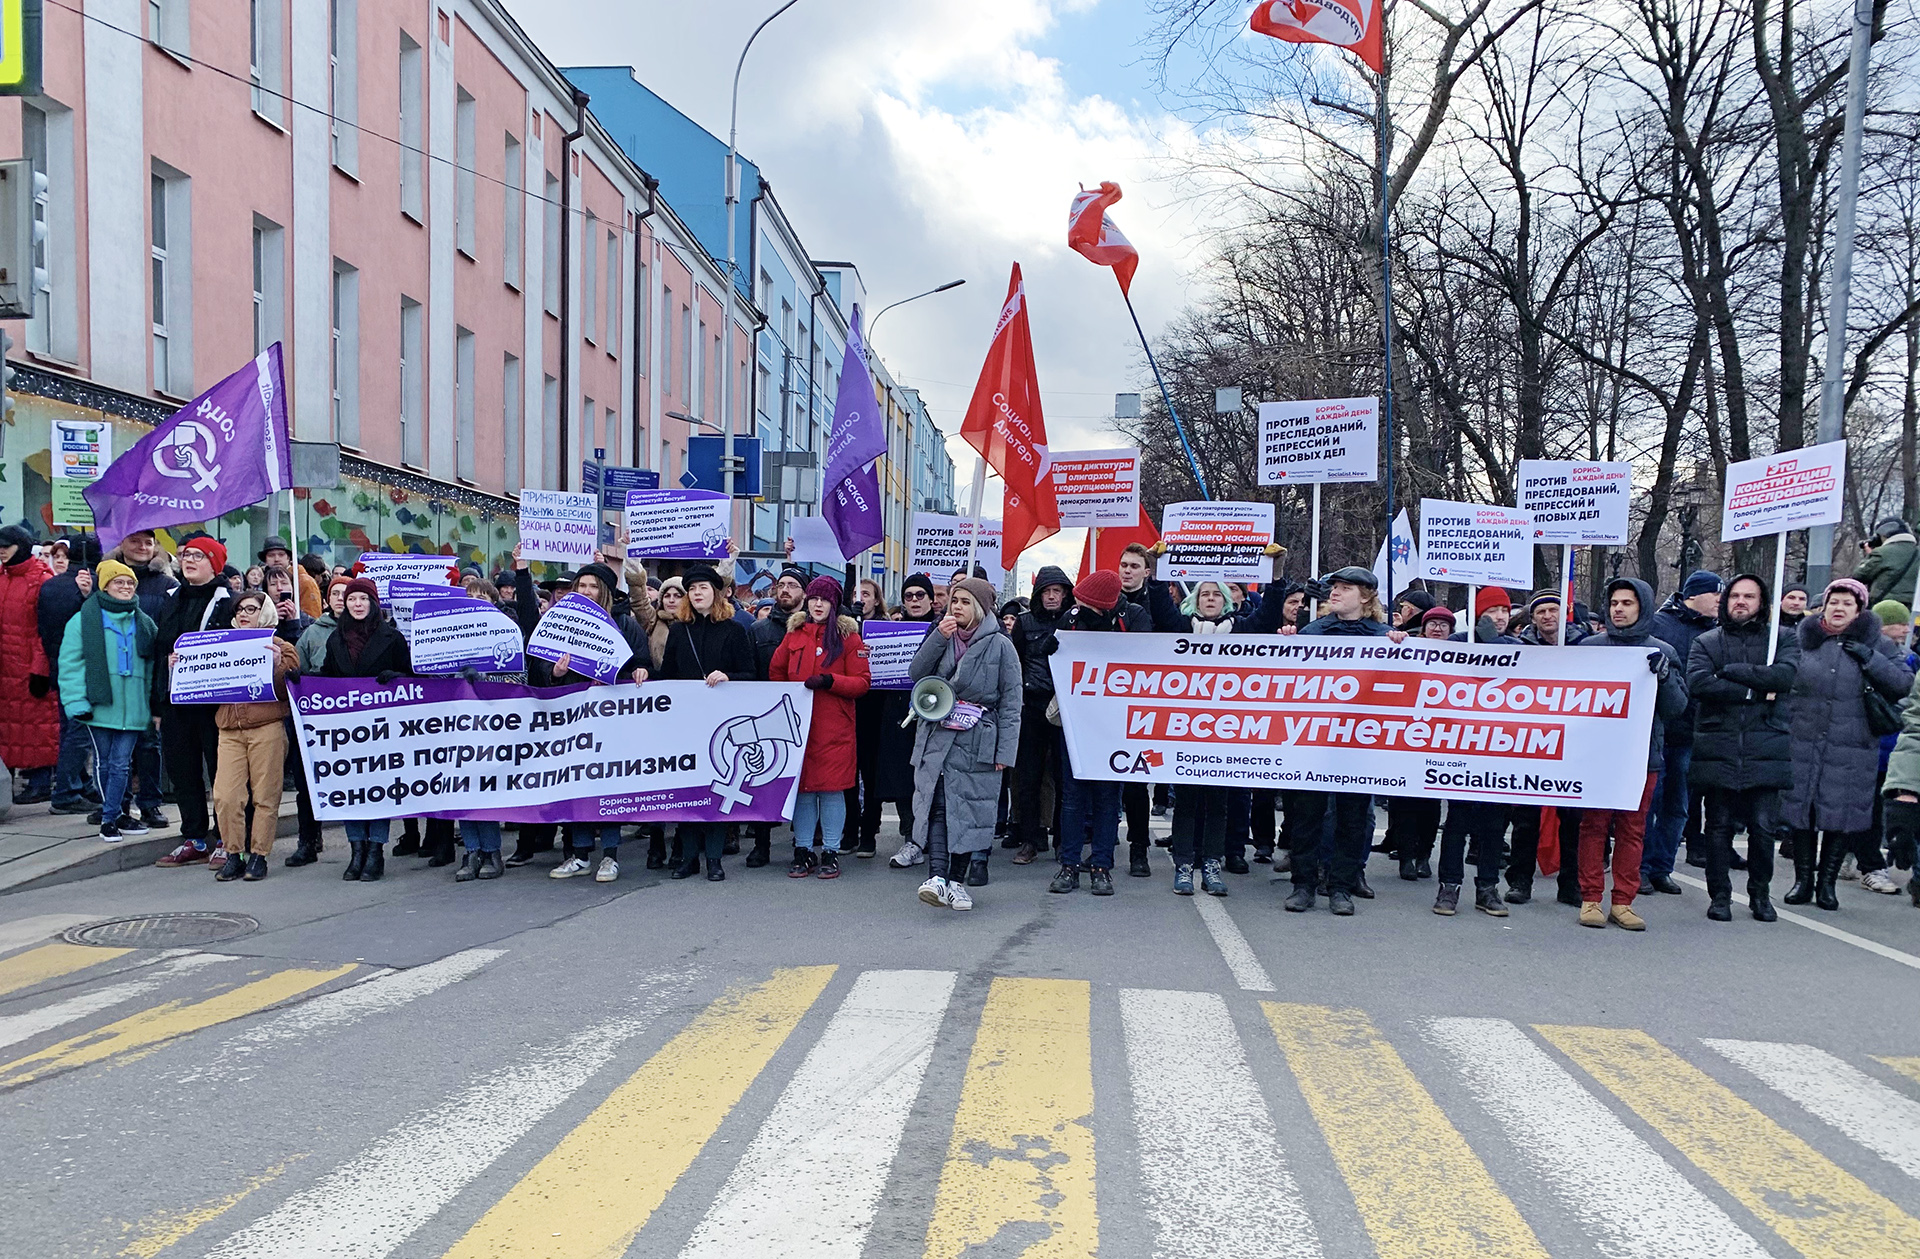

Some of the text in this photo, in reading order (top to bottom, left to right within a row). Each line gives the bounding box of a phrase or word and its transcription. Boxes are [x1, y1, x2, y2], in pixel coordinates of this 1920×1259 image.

[1315, 404, 1346, 414] БОРИСЬ
[1315, 408, 1372, 421] КАЖДЫЙ ДЕНЬ!
[1266, 417, 1310, 430] ПРОТИВ
[1266, 420, 1367, 442] ПРЕСЛЕДОВАНИЙ,
[1266, 436, 1340, 454] РЕПРЕССИЙ И
[1265, 448, 1346, 466] ЛИПОВЫХ ДЕЛ
[1052, 462, 1132, 472] Против диктатуры
[1767, 461, 1797, 475] Эта
[1068, 473, 1114, 482] олигархов
[1526, 477, 1567, 488] ПРОТИВ
[1572, 473, 1604, 482] КАЖДЫЙ
[1736, 468, 1830, 495] конституция
[1059, 482, 1132, 493] коррупционеров
[1525, 483, 1620, 500] ПРЕСЛЕДОВАНИЙ,
[1730, 479, 1834, 509] неисправима
[522, 492, 594, 506] ПРИНЯТЬ ИЗНА-
[1525, 497, 1595, 510] РЕПРЕССИЙ И
[520, 505, 592, 519] ЧАЛЬНУЮ ВЕРСИЮ
[630, 507, 679, 517] Антиженской
[1734, 496, 1829, 518] Голосуй против поправок
[630, 516, 676, 526] государства
[1578, 510, 1600, 520] ДЕЛ
[520, 520, 552, 532] ЗАКОНА
[554, 522, 561, 532] О
[1182, 522, 1252, 532] Закон против
[1428, 518, 1470, 526] ПРОТИВ
[631, 532, 674, 543] движением!
[1164, 533, 1268, 542] домашнего насилия
[1428, 529, 1524, 540] ПРЕСЛЕДОВАНИЙ,
[520, 538, 592, 555] НЕМ НАСИЛИИ
[916, 538, 999, 548] ПРЕСЛЕДОВНИЙ,
[1175, 544, 1232, 554] кризисный
[1234, 546, 1264, 555] центр
[1428, 540, 1500, 550] РЕПРЕССИЙ И
[915, 548, 968, 557] РЕПРЕССИЙ
[1426, 552, 1505, 562] ЛИПОВЫХ ДЕЛ
[914, 558, 960, 566] ЛИПОВЫХ
[1180, 554, 1220, 564] каждый
[1222, 554, 1259, 566] район!
[364, 564, 446, 573] Сестёр Хачатурян
[370, 572, 420, 582] оправдать!
[546, 610, 601, 630] Прекратить
[432, 623, 475, 632] нападкам
[542, 621, 614, 646] преследование
[414, 630, 488, 646] репродуктивные
[536, 629, 614, 656] Юлии Цветковой
[875, 642, 902, 651] разовый
[1174, 638, 1521, 668] Эта конституция неисправима!
[180, 650, 228, 664] Руки прочь
[189, 663, 216, 673] права
[234, 655, 266, 668] аборт!
[297, 684, 424, 713] @SocFemAlt
[1072, 668, 1628, 716] Демократию рабочим
[302, 694, 672, 752] Строй женское движение
[1128, 711, 1562, 756] и всем угнетённым
[414, 732, 603, 768] патриархата,
[1110, 750, 1150, 774] СА
[1176, 752, 1283, 766] Борись вместе с
[1426, 759, 1467, 768] Наш сайт
[479, 774, 497, 792] и
[506, 753, 696, 792] капитализма
[1175, 766, 1406, 788] Социалистической Альтернативой
[1424, 768, 1582, 794] Socialist.News
[599, 797, 712, 816] СоцФем Альтернативой!
[600, 796, 632, 806] Борись
[634, 794, 666, 804] вместе
